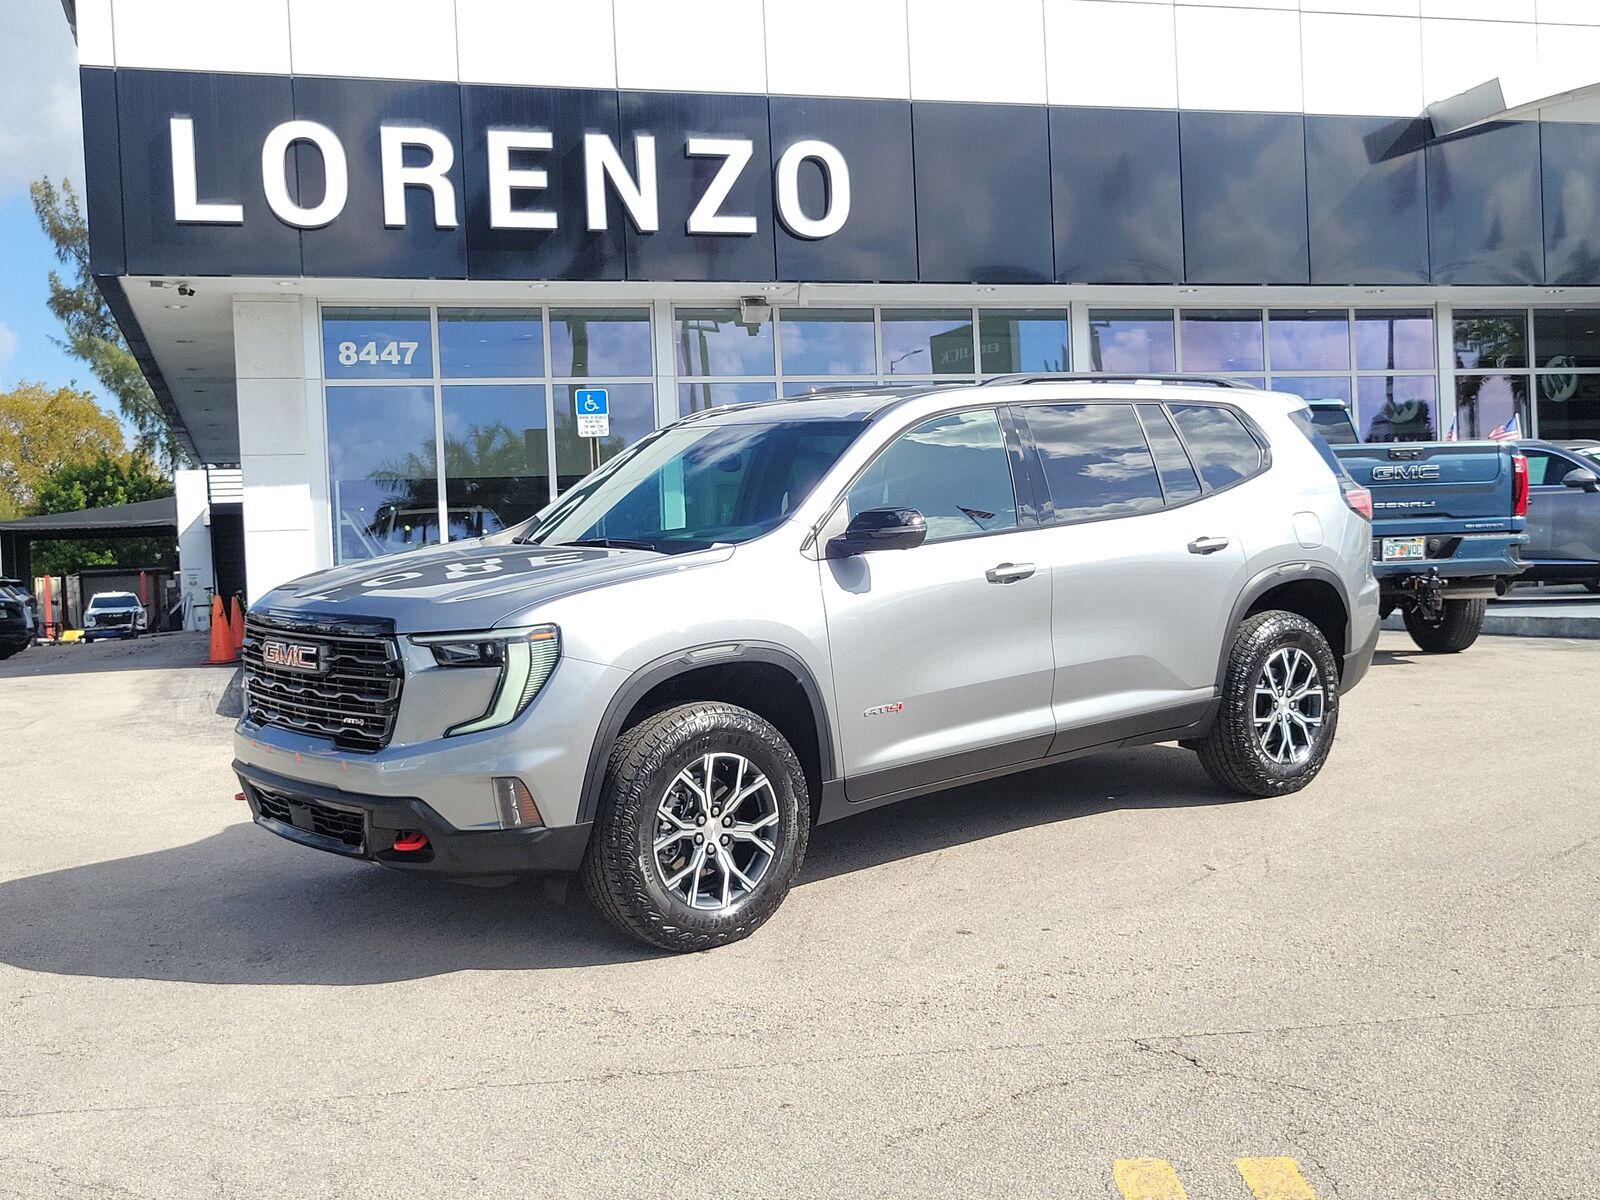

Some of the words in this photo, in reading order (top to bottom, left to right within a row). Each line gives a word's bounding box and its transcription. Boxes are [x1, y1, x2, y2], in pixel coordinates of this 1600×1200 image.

[169, 115, 851, 240] LORENZO
[338, 341, 419, 366] 8447
[1372, 464, 1440, 481] GMC
[1374, 501, 1436, 509] DENALI
[263, 640, 318, 670] GMC
[863, 701, 903, 718] AT4
